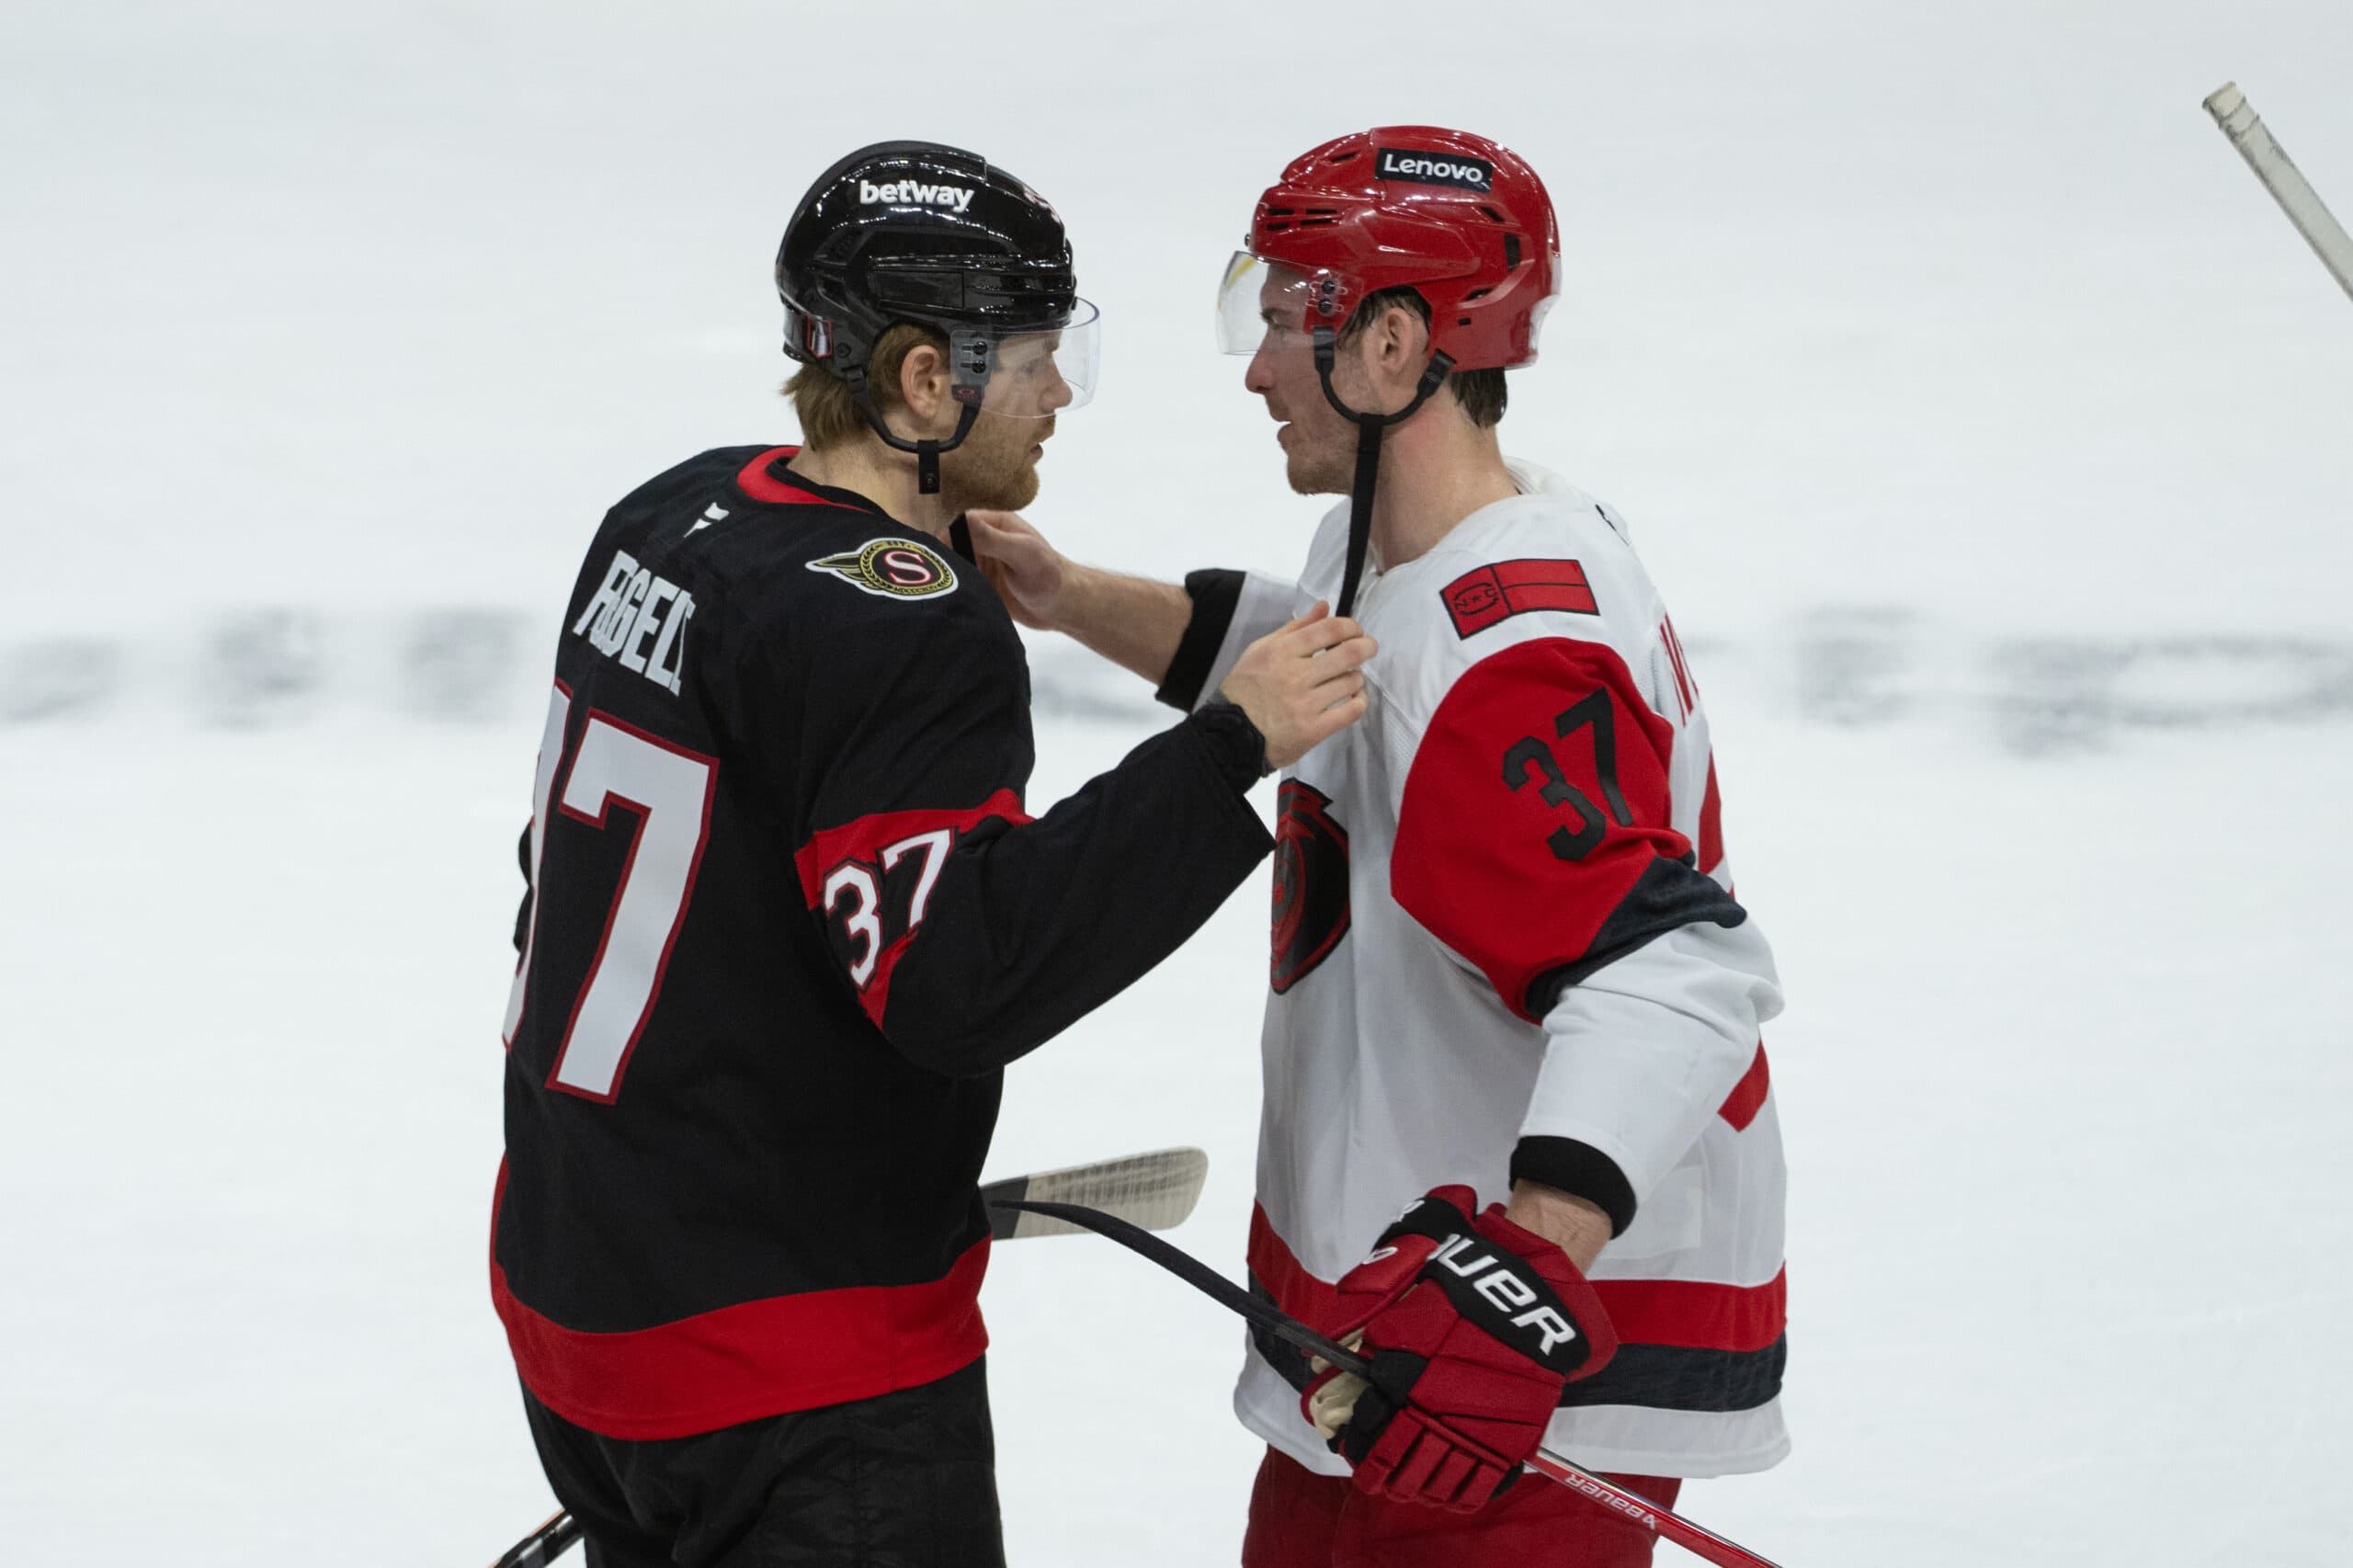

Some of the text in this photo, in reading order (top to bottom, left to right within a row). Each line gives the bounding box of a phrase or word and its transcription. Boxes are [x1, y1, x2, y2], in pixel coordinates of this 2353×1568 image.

[1383, 153, 1483, 182] Lenovo
[859, 179, 974, 212] betway
[885, 551, 932, 585] S
[1502, 686, 1633, 862] 37
[824, 828, 956, 989] 37
